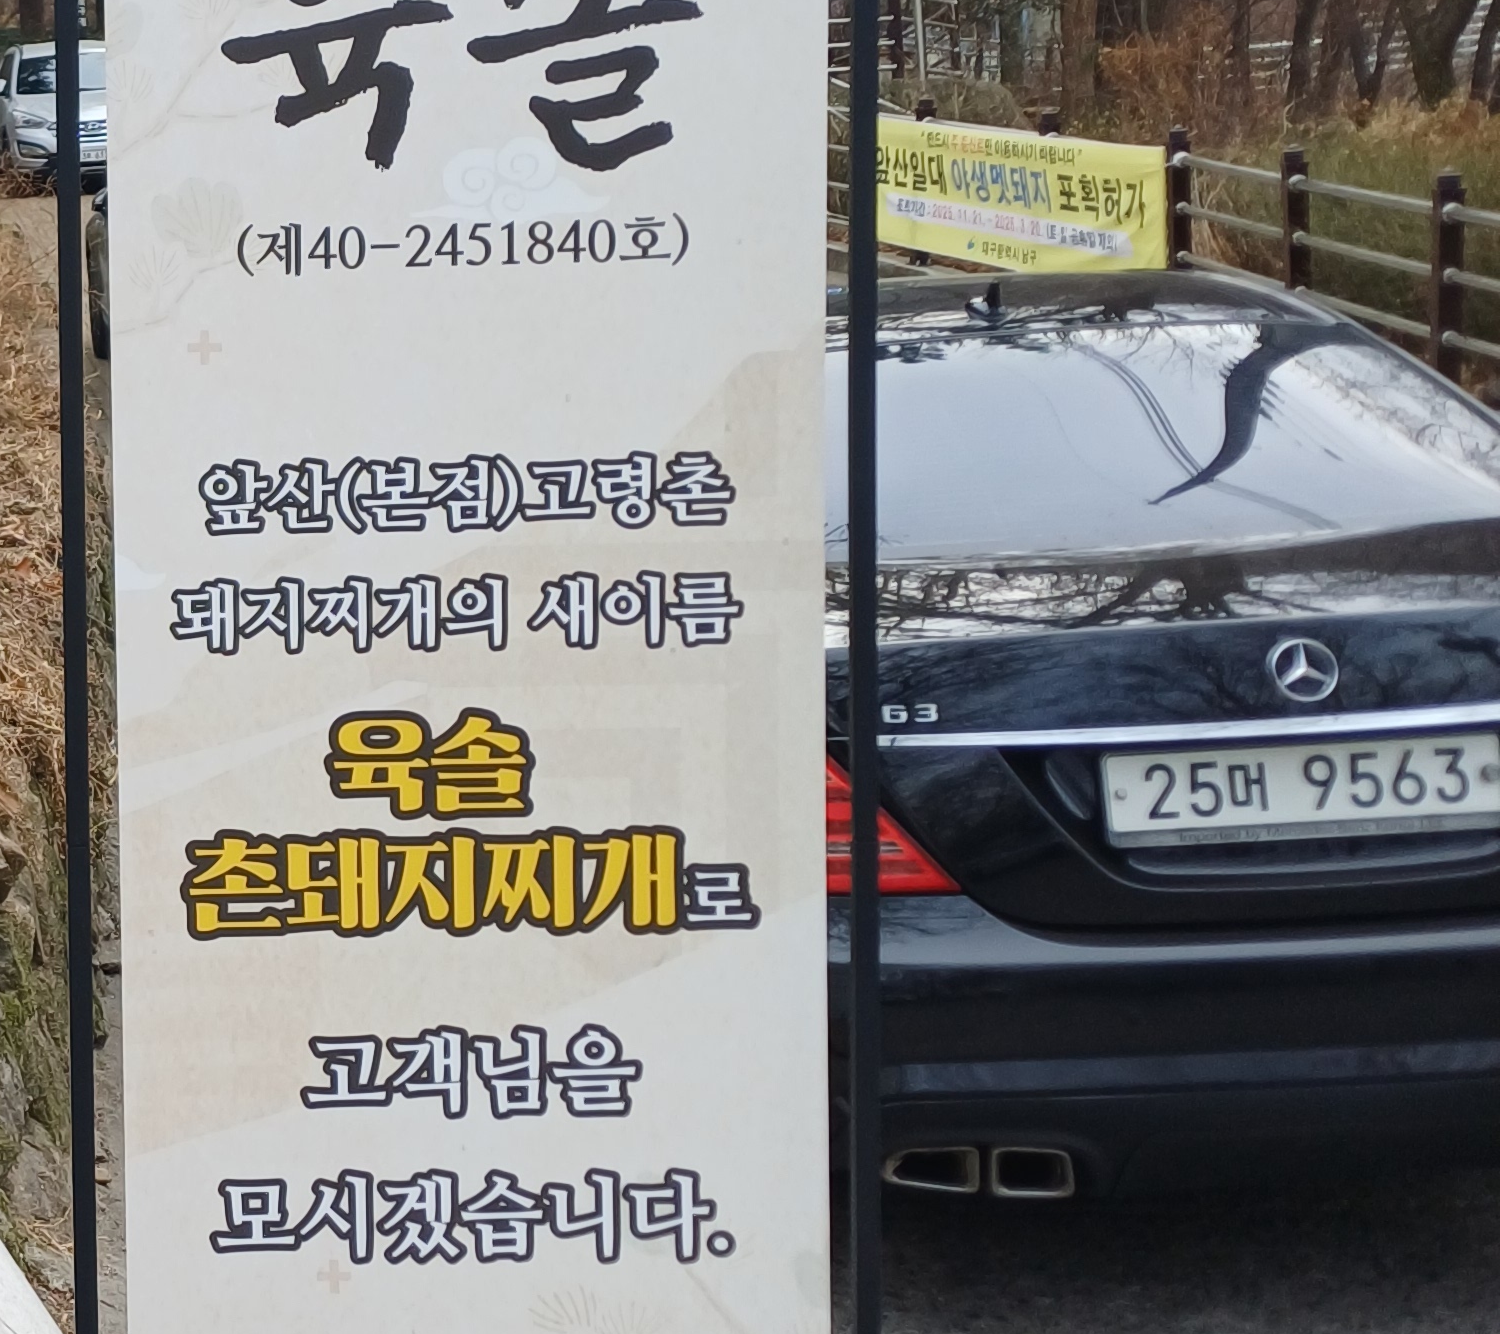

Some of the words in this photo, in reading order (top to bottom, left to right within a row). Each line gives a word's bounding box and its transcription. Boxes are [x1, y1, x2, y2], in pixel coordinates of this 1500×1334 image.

[876, 145, 947, 196] 앞산일대
[951, 158, 1051, 213] 야생멧돼지
[1057, 173, 1146, 228] 포획허가
[236, 211, 691, 277] (제40-2451840호)
[200, 452, 735, 535] 앞산(본점)고령촌
[170, 573, 508, 655] 돼지찌개의
[528, 571, 743, 649] 새이름
[324, 707, 535, 820] 육솔
[1144, 760, 1270, 820] 25머
[1302, 747, 1470, 811] 9563
[181, 827, 760, 940] 촌돼지찌개로
[300, 1024, 642, 1120] 고객님을
[209, 1168, 737, 1265] 모시겠습니다.
